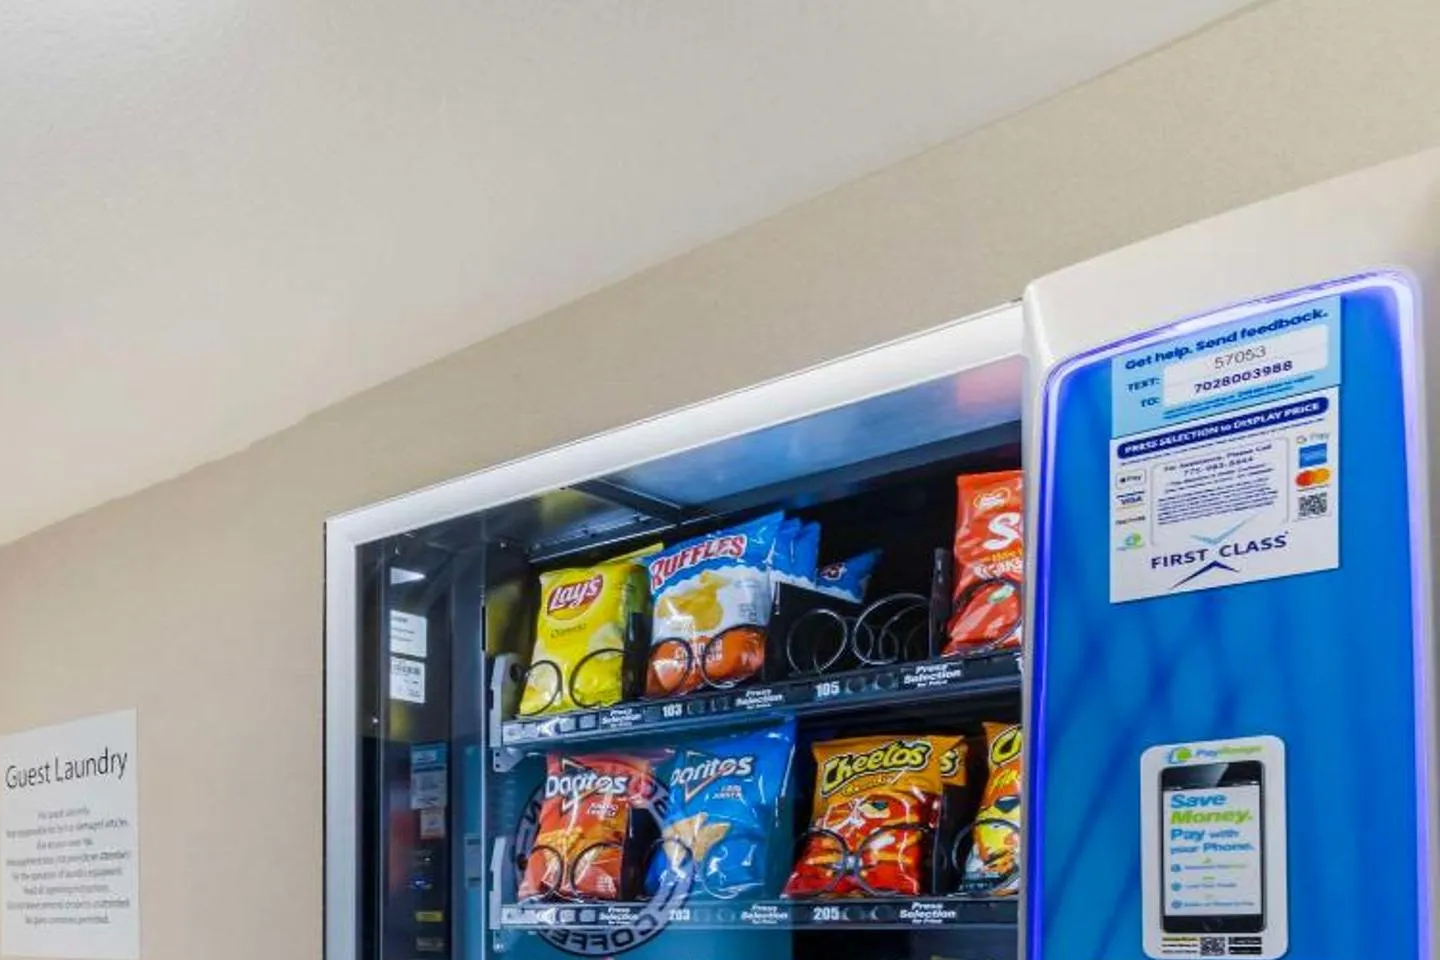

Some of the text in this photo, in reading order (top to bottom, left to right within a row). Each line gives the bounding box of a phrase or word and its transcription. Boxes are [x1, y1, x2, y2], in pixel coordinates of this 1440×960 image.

[1125, 308, 1328, 370] Get help. Send feedback.
[1214, 345, 1266, 369] 57053
[1194, 360, 1293, 394] 7028003988
[1158, 425, 1220, 448] SELECTION
[1233, 411, 1283, 430] DISPLAY
[1283, 402, 1320, 417] PRICE
[650, 535, 747, 588] RUFFLES
[1151, 535, 1287, 569] FIRST CLASS
[816, 682, 840, 697] 105
[662, 704, 682, 718] 103
[5, 747, 128, 790] Guest Laundry
[669, 755, 755, 788] Doritos
[822, 740, 932, 798] Cheetos
[545, 774, 628, 799] Doritos
[1170, 793, 1226, 809] Save
[1169, 809, 1252, 825] Money.
[1170, 827, 1239, 841] Pay with
[814, 906, 841, 921] 205
[899, 909, 956, 919] Selection
[911, 902, 943, 910] Press
